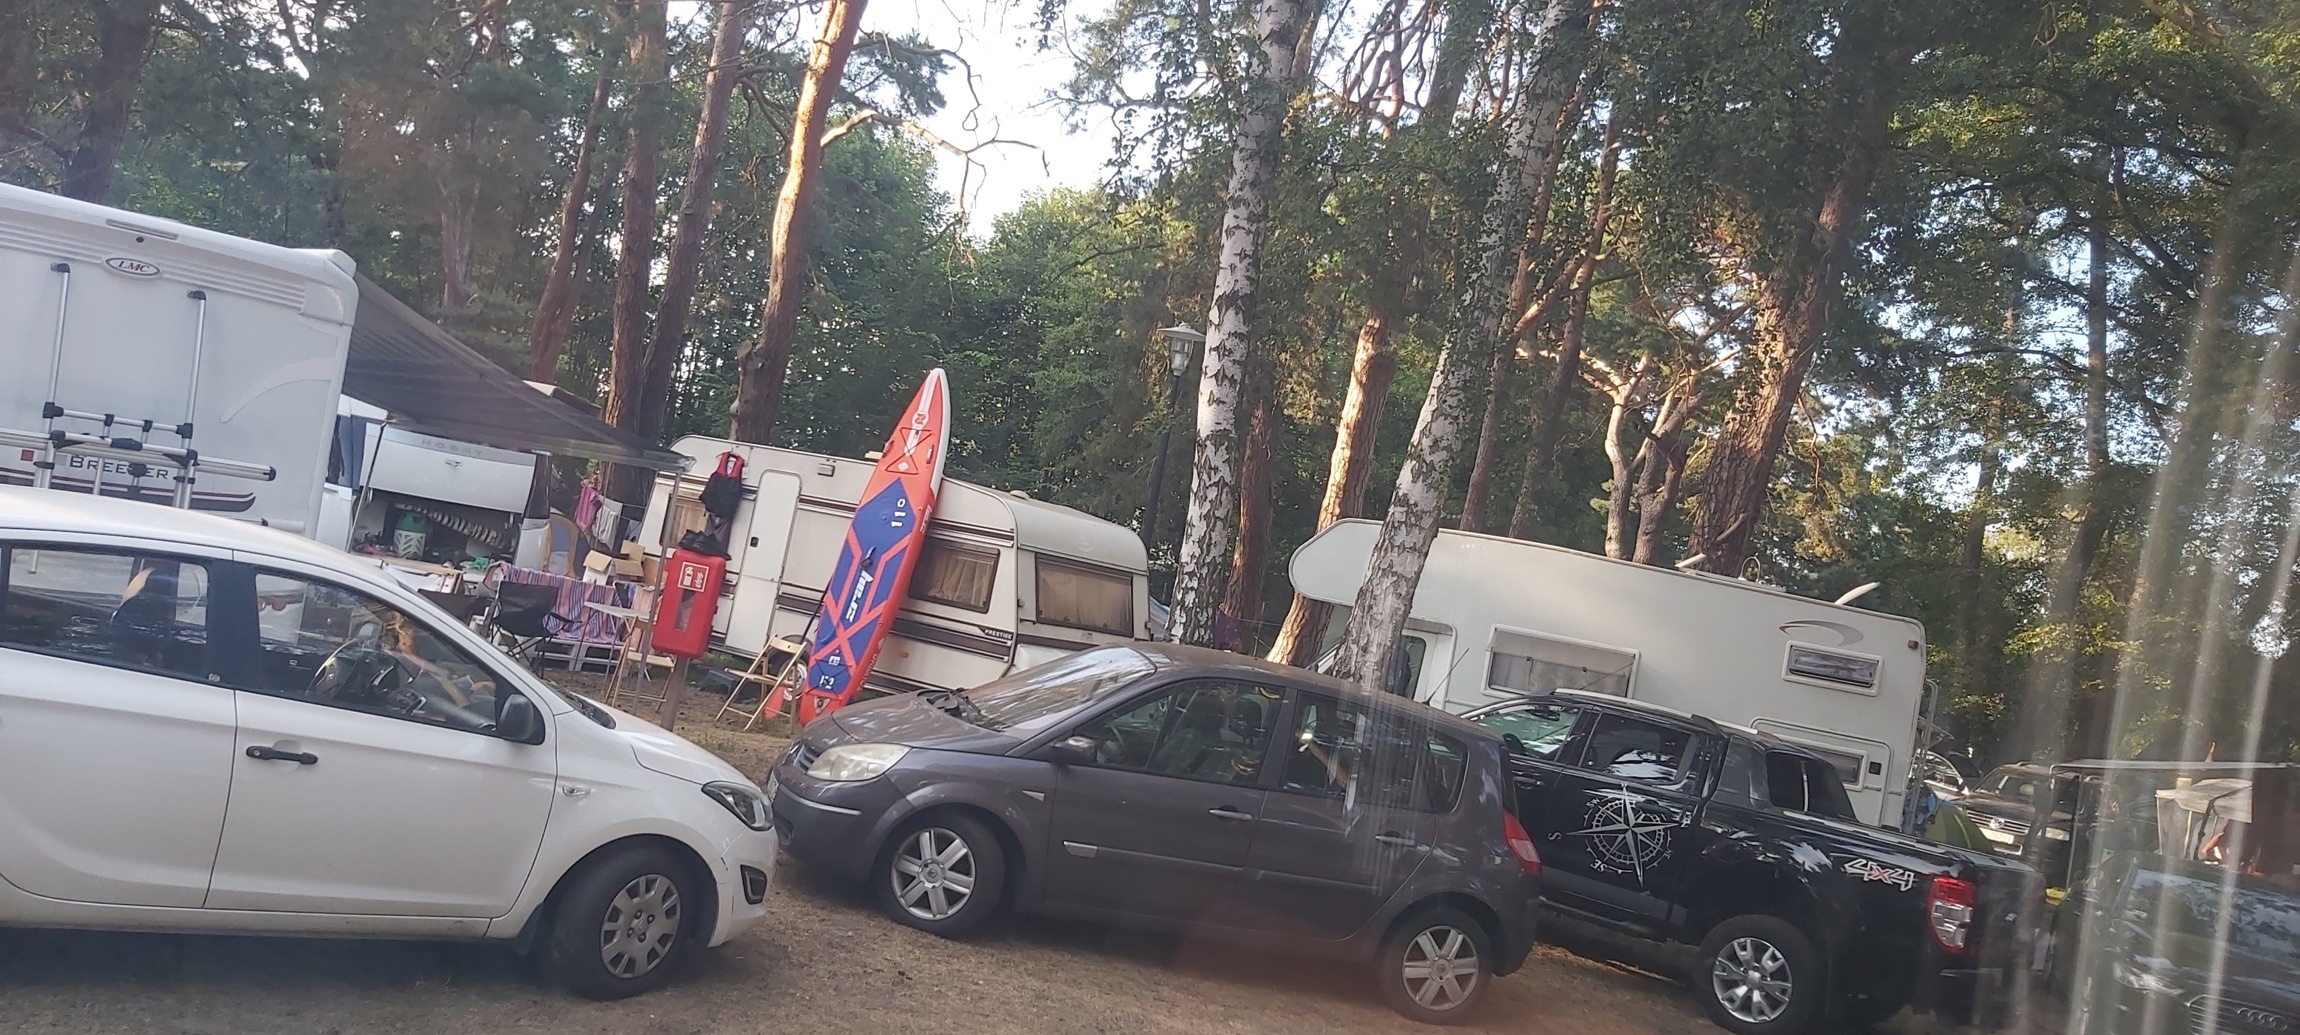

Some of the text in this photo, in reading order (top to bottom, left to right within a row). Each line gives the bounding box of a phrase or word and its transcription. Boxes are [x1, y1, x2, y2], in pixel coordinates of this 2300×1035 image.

[118, 260, 150, 273] LMC
[70, 455, 169, 480] BREEER
[984, 629, 1013, 640] PRESTIGE
